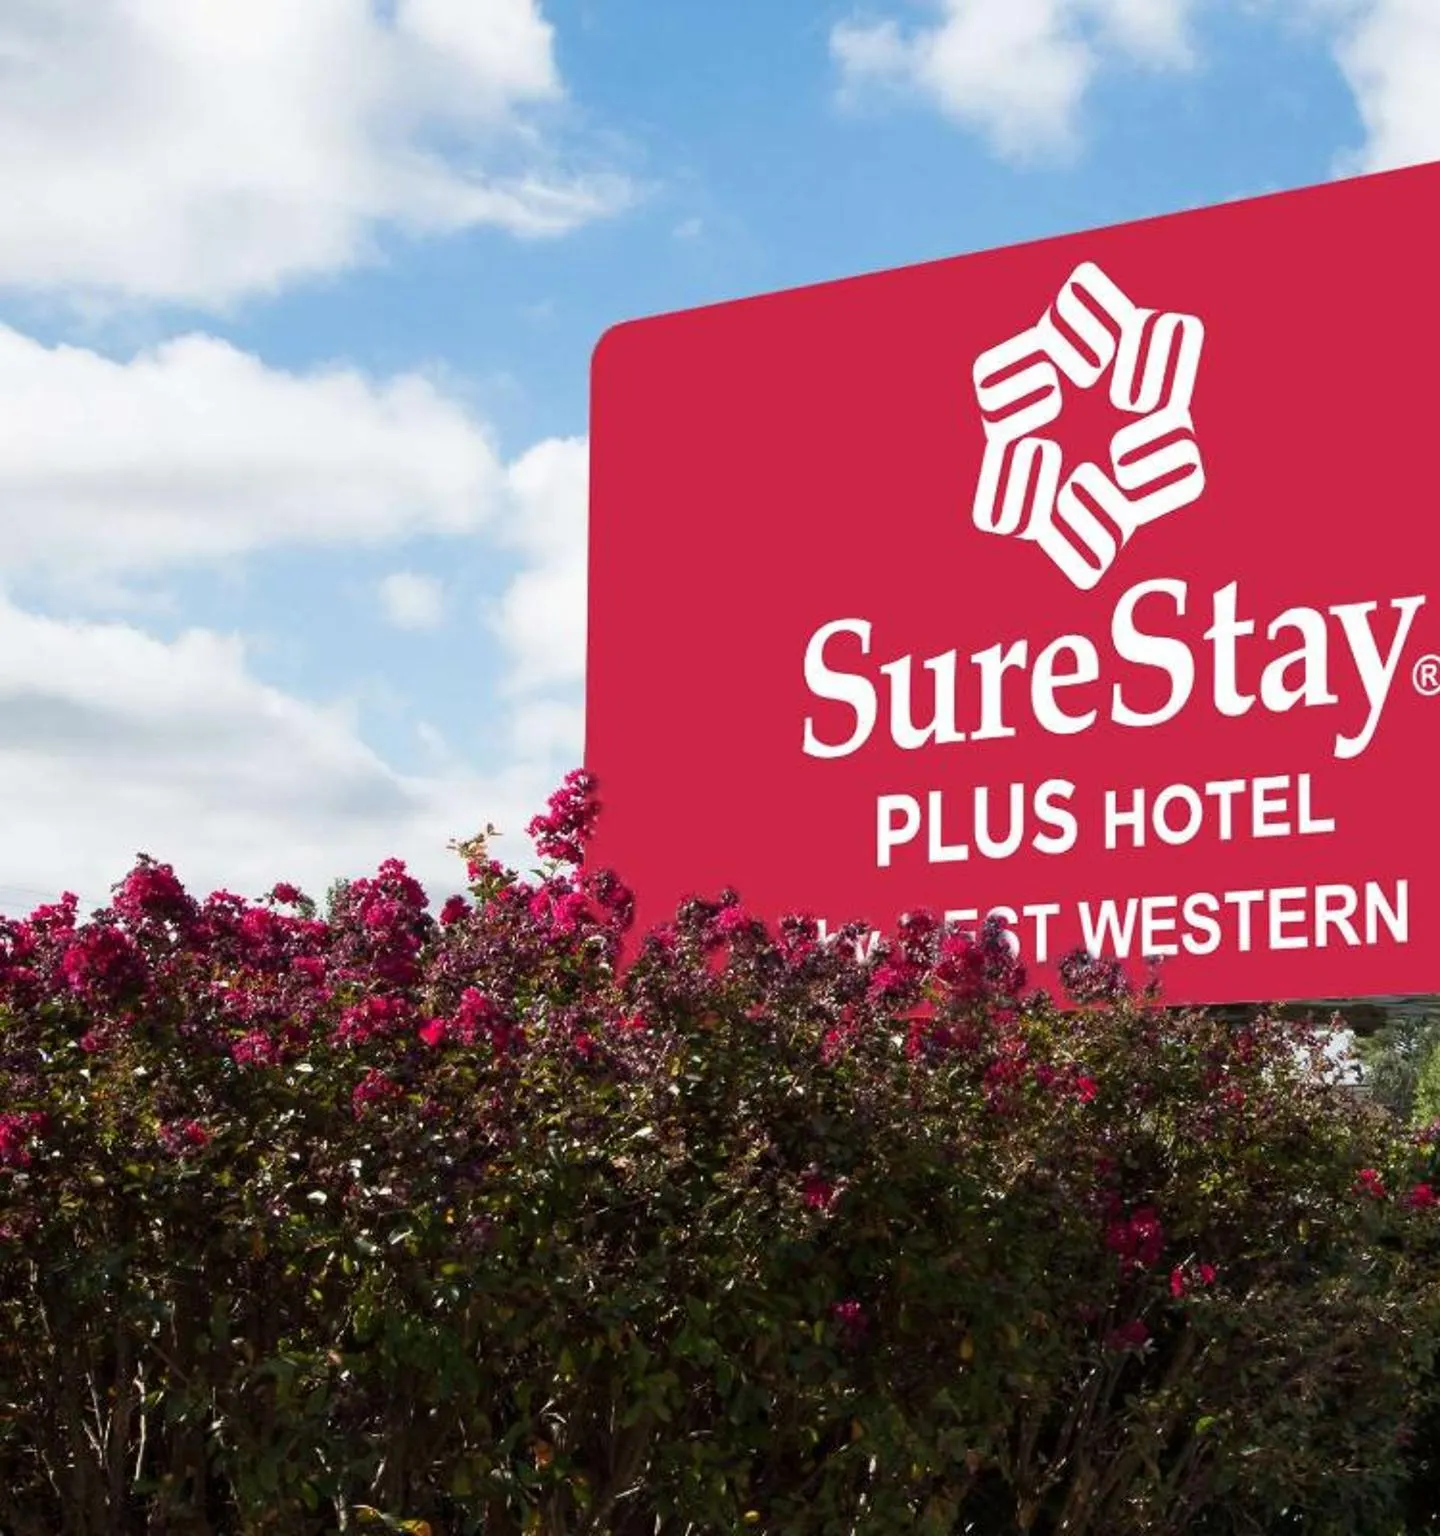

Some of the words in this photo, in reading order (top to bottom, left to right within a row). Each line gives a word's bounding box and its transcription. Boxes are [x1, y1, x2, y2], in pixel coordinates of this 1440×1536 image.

[876, 779, 1079, 867] PLUS
[1104, 773, 1336, 848] HOTEL
[900, 903, 1061, 964] EST
[1077, 879, 1408, 961] WESTERN
